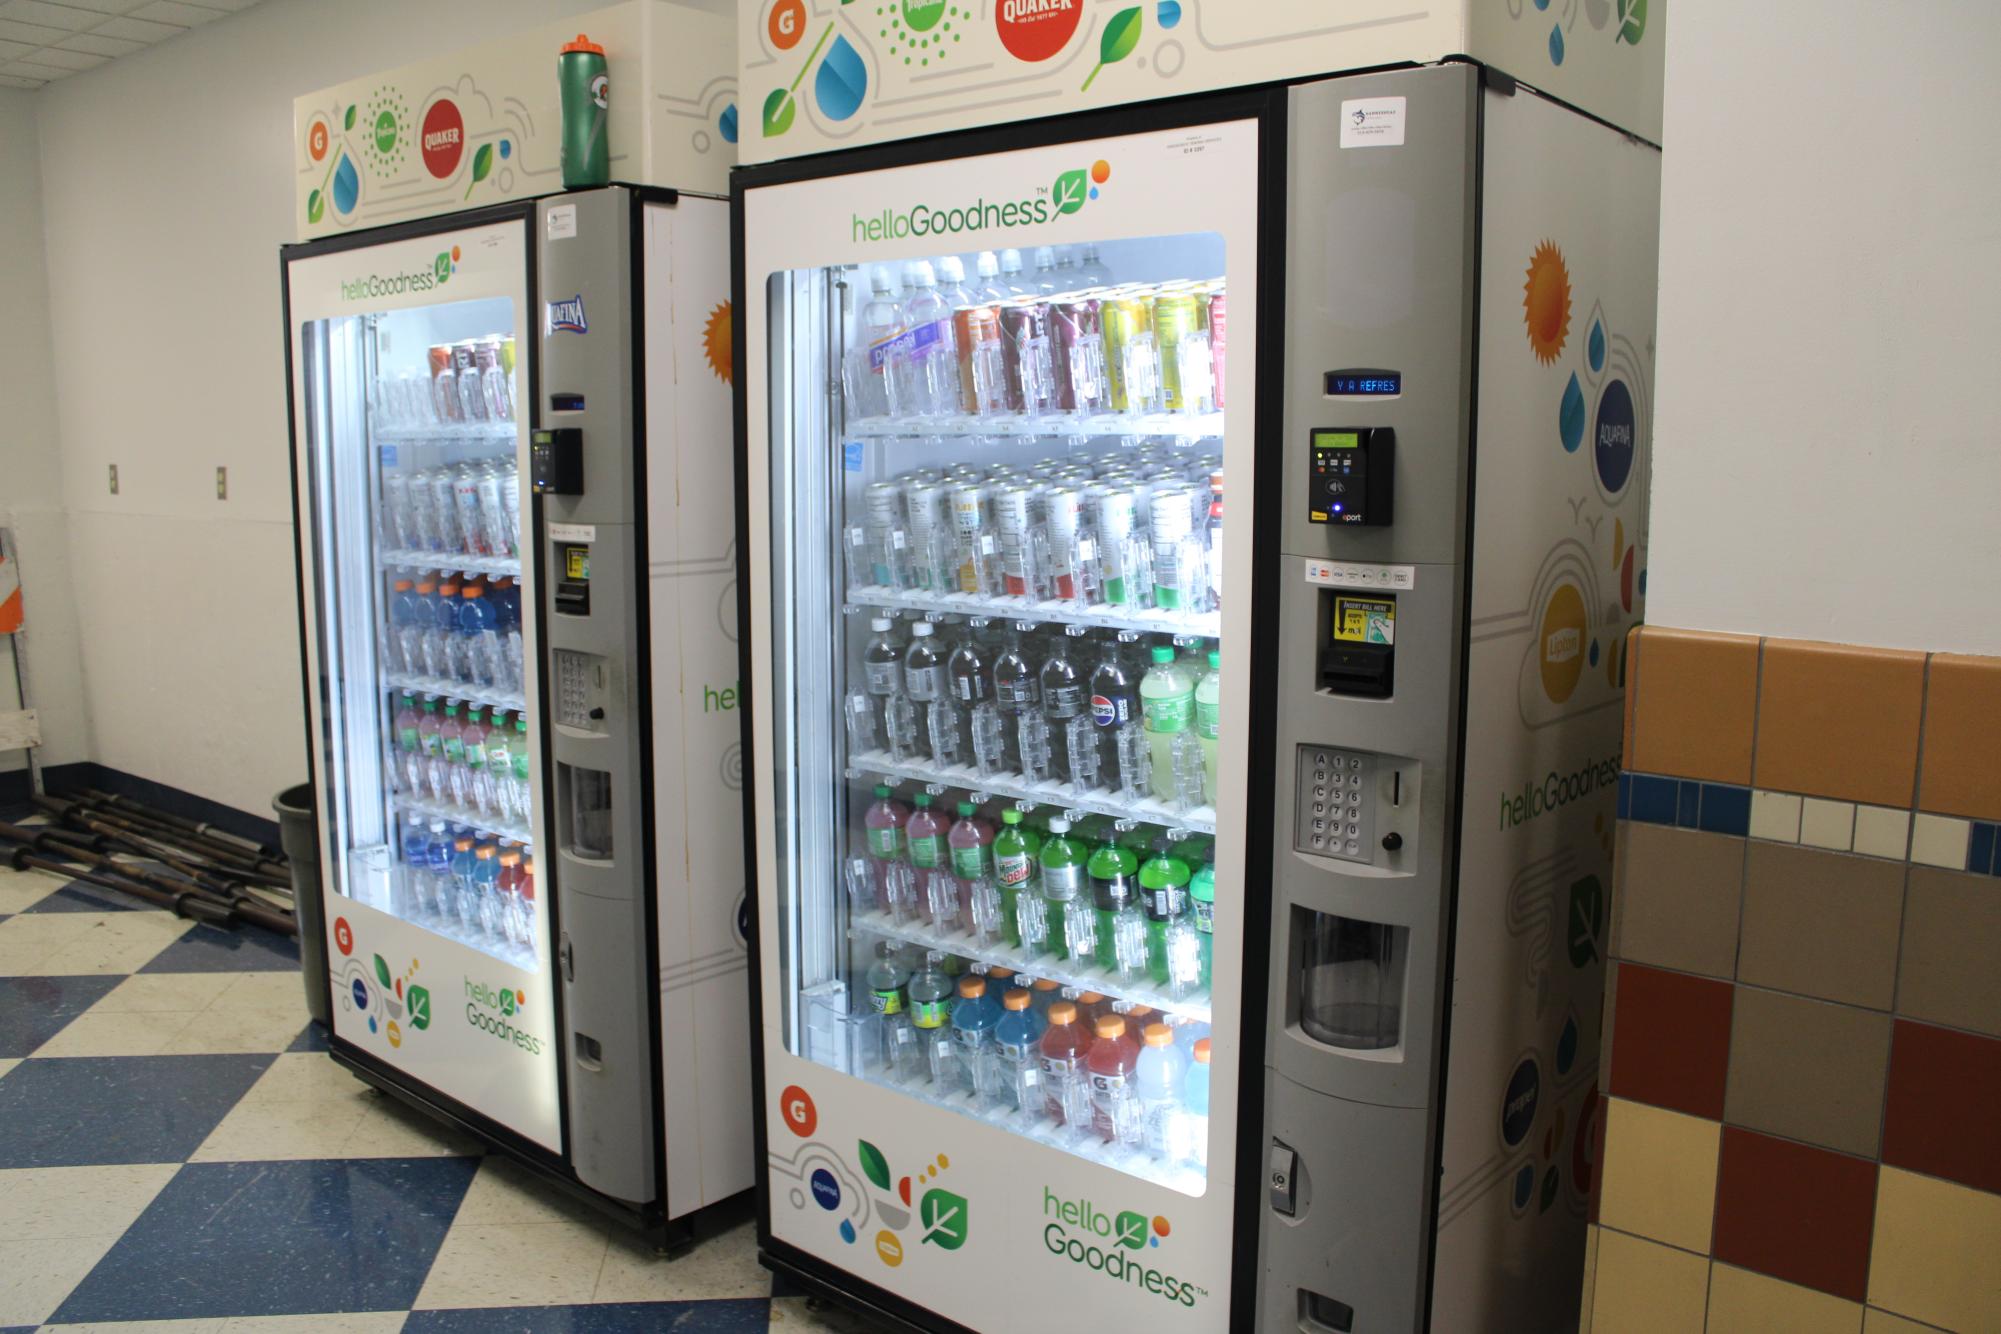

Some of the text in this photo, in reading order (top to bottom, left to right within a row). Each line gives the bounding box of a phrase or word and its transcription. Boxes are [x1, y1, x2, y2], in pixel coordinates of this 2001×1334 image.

[778, 9, 795, 35] G
[314, 132, 323, 149] G
[425, 128, 460, 152] QUAKER
[853, 199, 1048, 242] helloGoodness
[341, 270, 433, 301] helloGoodness
[1360, 380, 1396, 392] REFRES
[1599, 423, 1631, 447] AQUAFINA
[1550, 635, 1578, 656] Lipton
[1318, 755, 1359, 768] A 1 2
[1318, 771, 1358, 784] B 3 4
[1317, 787, 1357, 801] C 5 6
[1316, 804, 1357, 818] D 7 8
[1316, 820, 1322, 828] E
[1333, 822, 1339, 831] 9
[1315, 835, 1321, 844] F
[464, 976, 498, 1009] hello
[466, 1002, 540, 1055] Goodness
[1093, 1076, 1108, 1091] G
[790, 1099, 807, 1124] G
[1043, 1185, 1112, 1238] hello
[1043, 1223, 1196, 1307] Goodness
